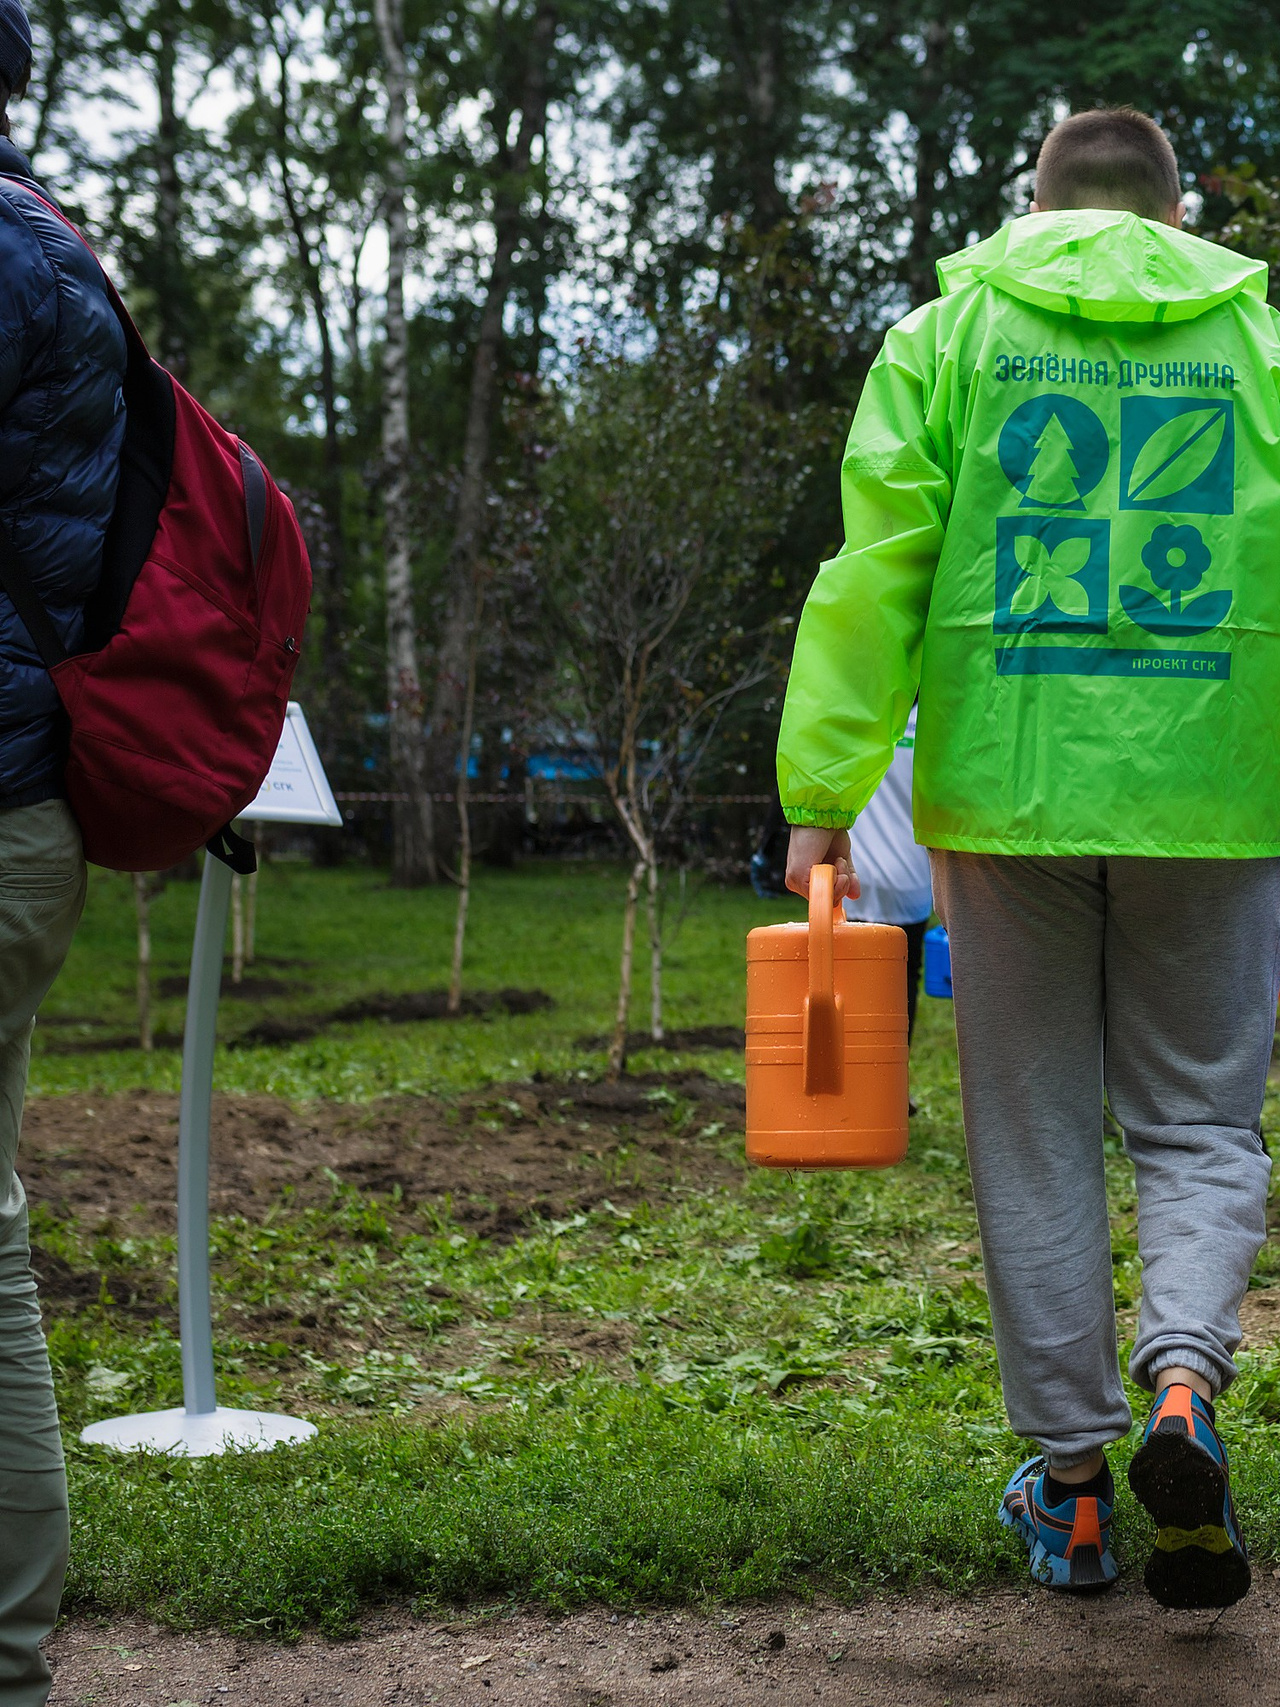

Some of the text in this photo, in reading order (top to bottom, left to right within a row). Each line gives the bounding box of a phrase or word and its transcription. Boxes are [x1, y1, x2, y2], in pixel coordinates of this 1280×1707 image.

[1132, 658, 1216, 672] ПРОЕКТ СГК
[273, 782, 294, 792] СГК
